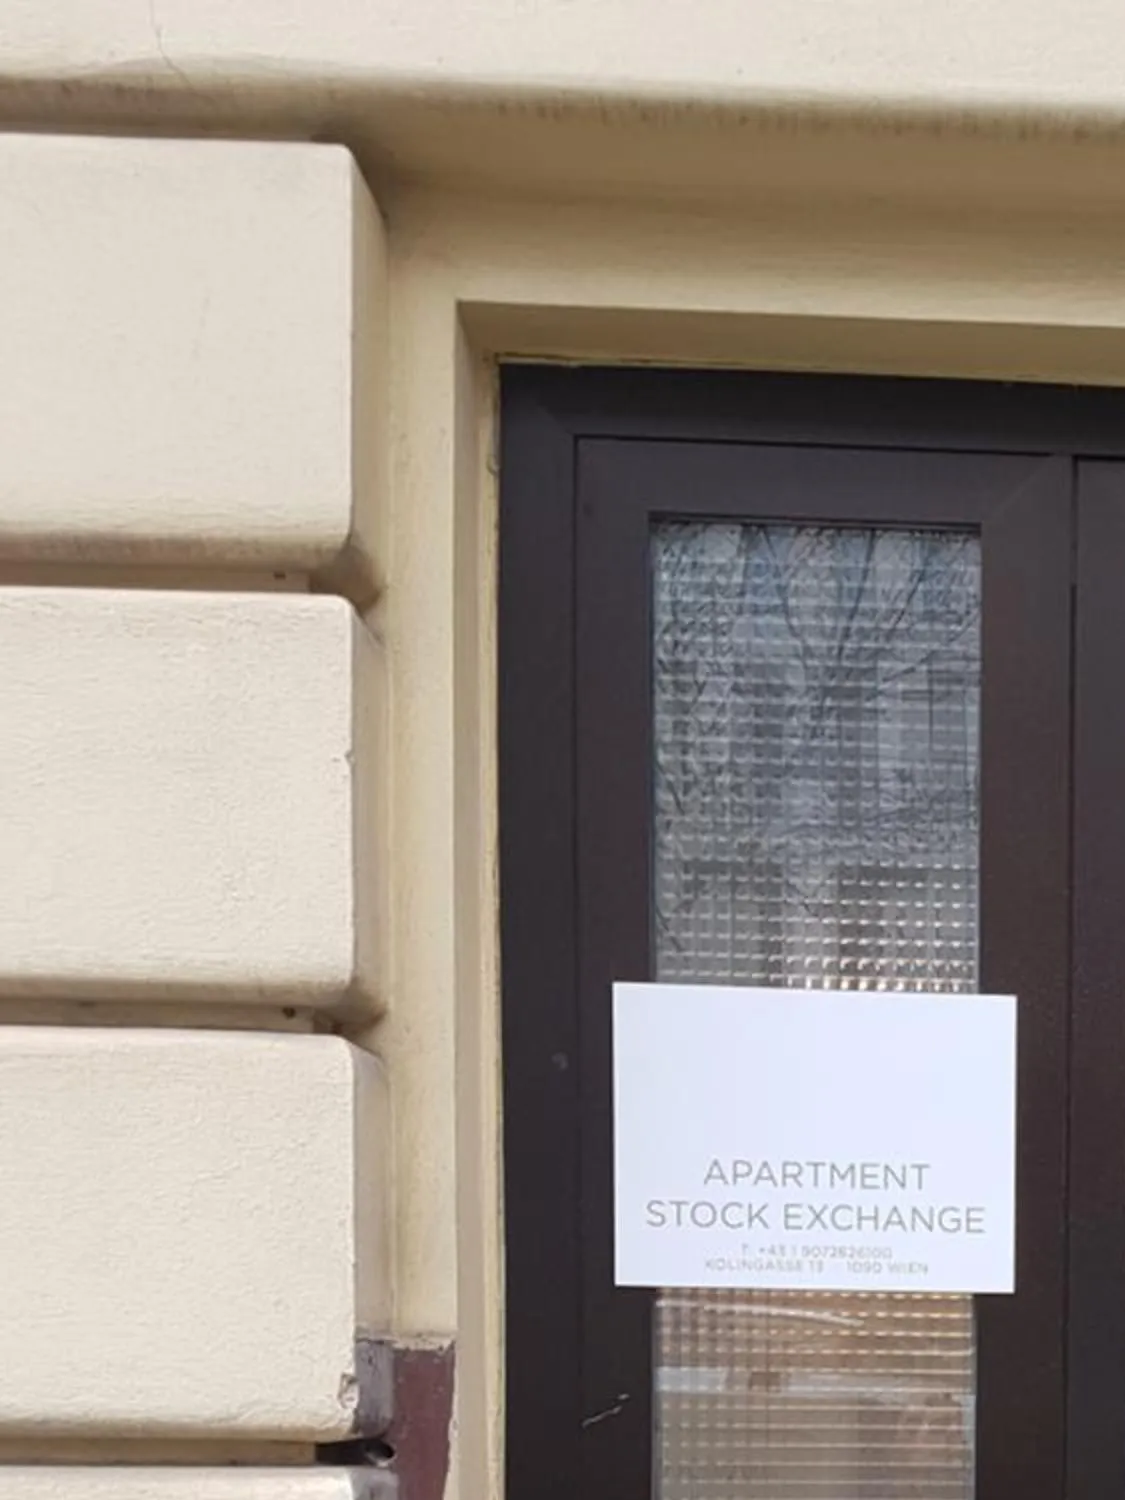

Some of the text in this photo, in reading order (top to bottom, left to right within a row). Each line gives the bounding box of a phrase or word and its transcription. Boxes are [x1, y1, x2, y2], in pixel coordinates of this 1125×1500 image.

[703, 1158, 930, 1190] APARTMENT
[646, 1200, 986, 1234] STOCK EXCHANGE
[705, 1258, 801, 1272] KOLINGASSE
[846, 1261, 882, 1274] 1090
[888, 1262, 929, 1275] WIEN
